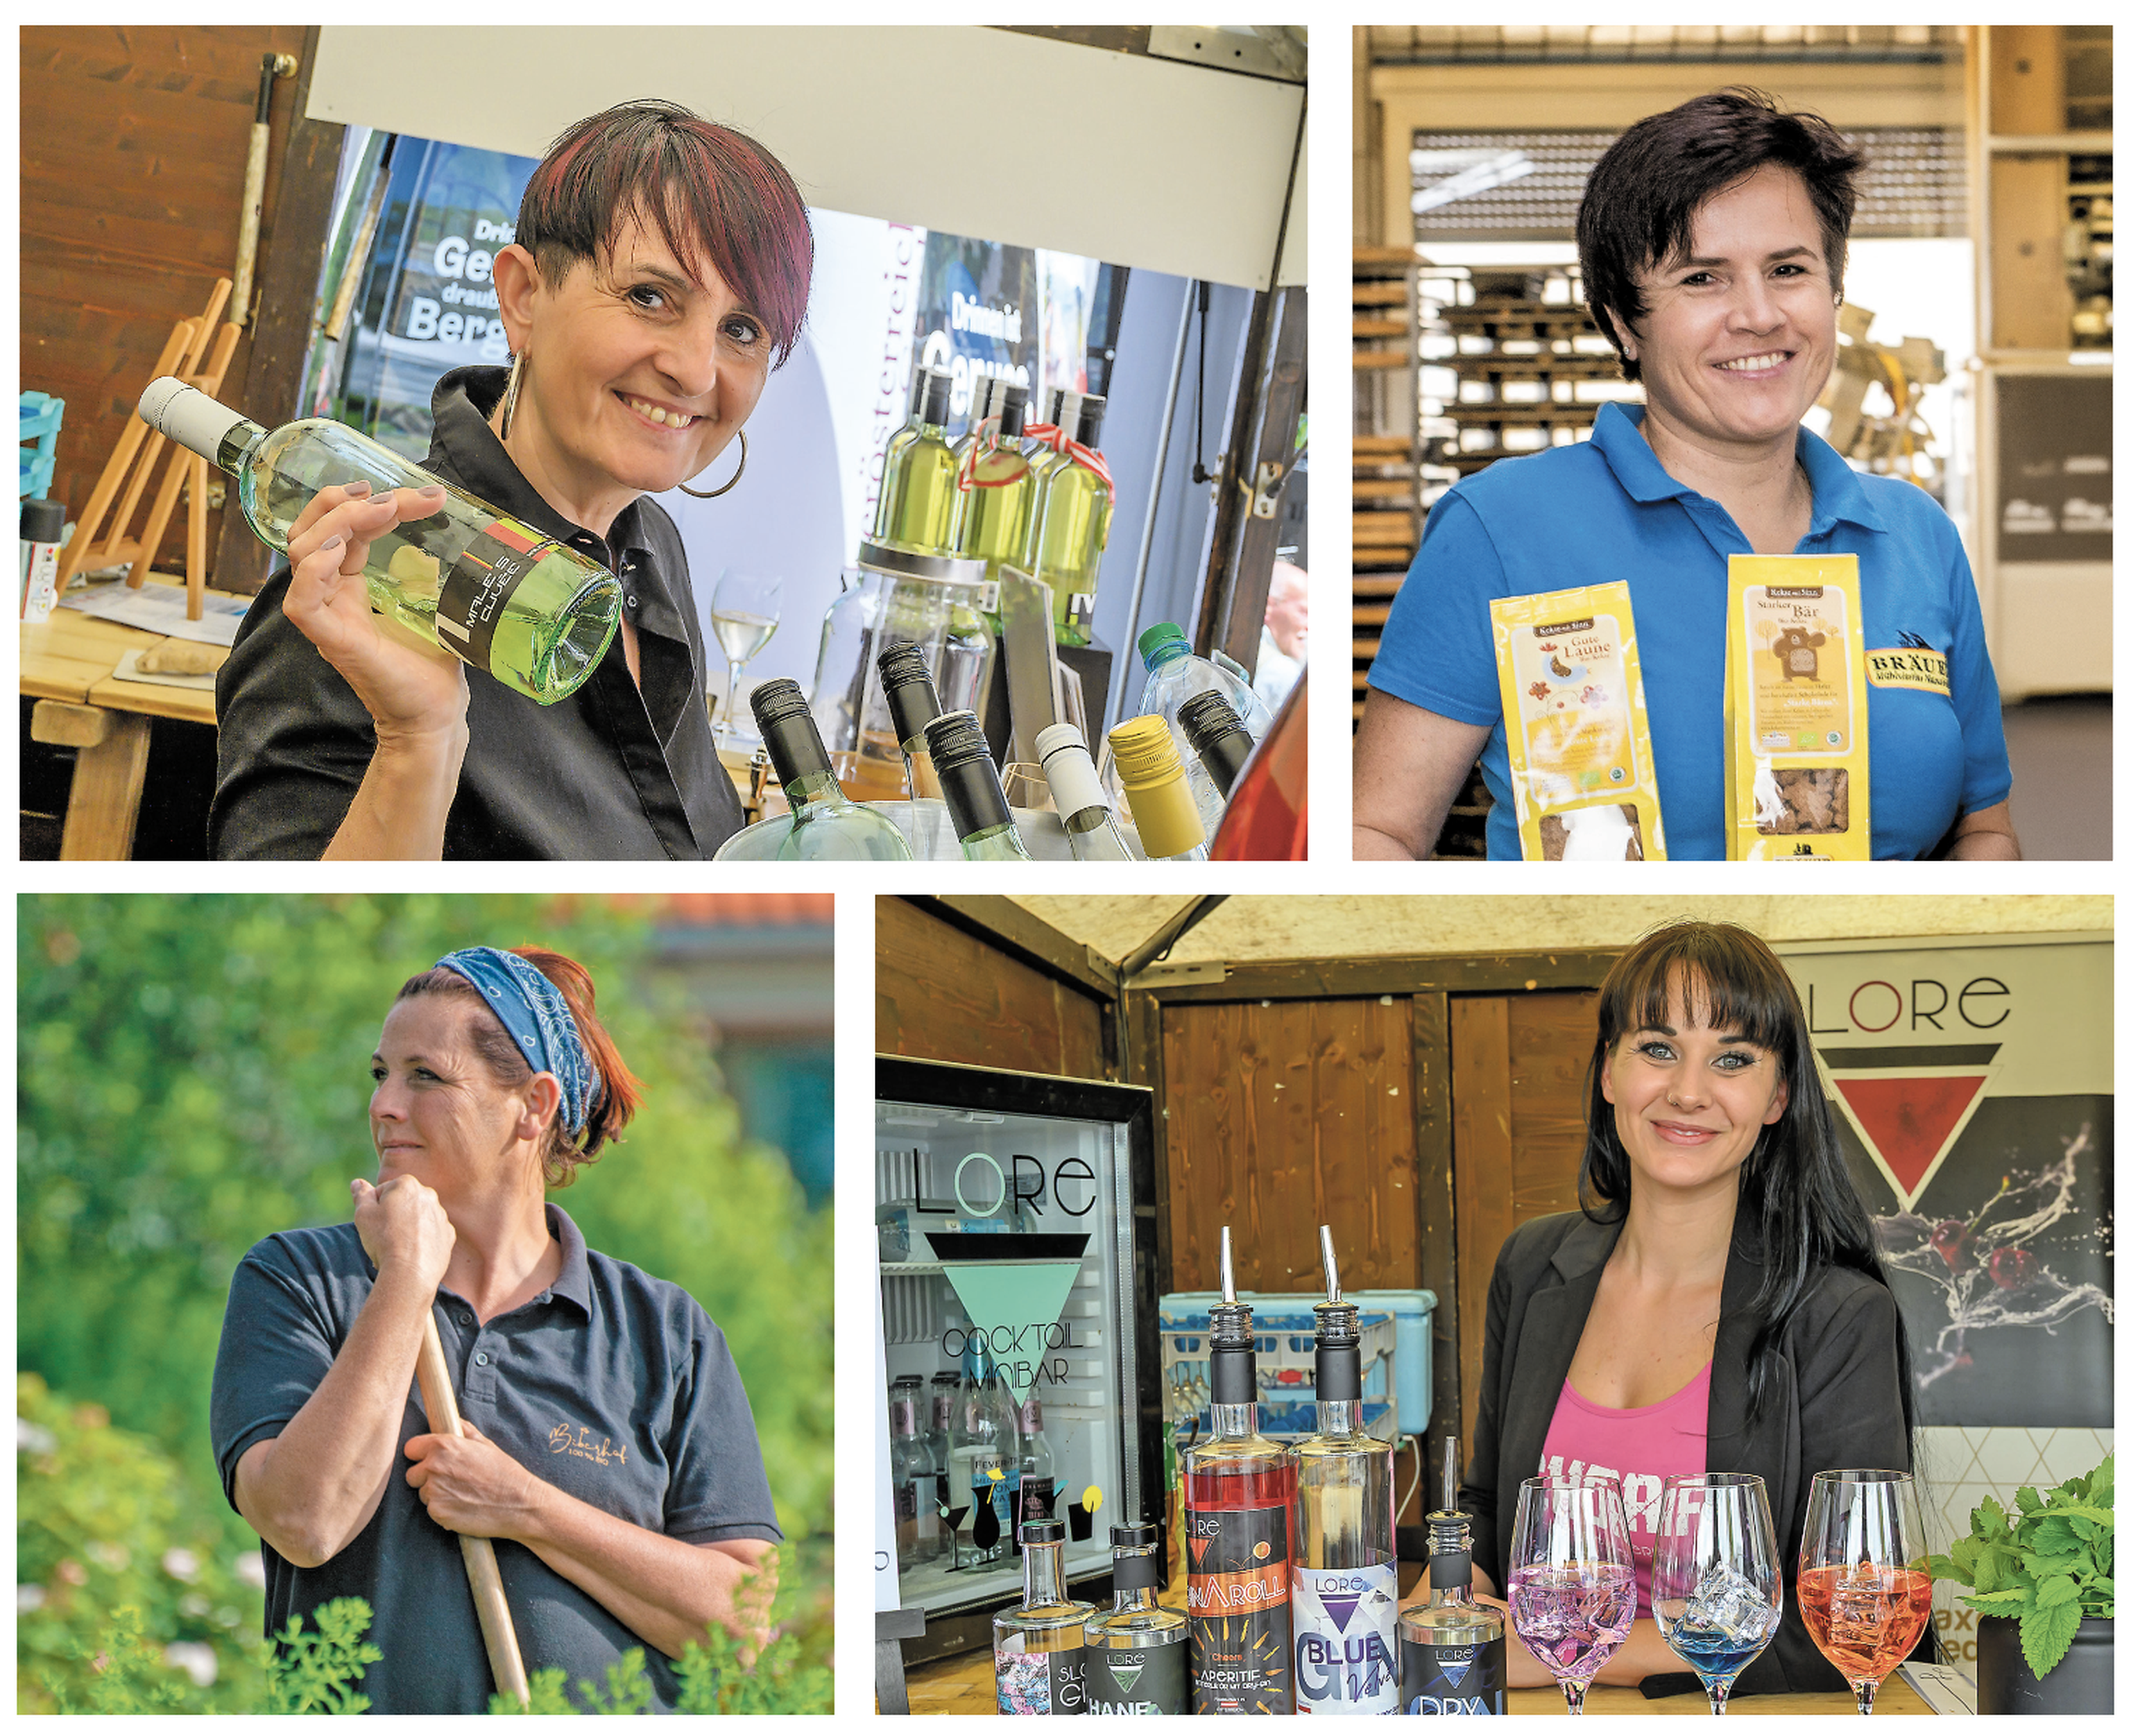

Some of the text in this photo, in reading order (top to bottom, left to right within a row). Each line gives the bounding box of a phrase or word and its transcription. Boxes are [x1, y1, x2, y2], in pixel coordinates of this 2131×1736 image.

[434, 236, 494, 284] Ge
[1757, 600, 1792, 609] Starker
[1792, 604, 1819, 619] Bär
[1571, 635, 1600, 646] Gute
[1564, 643, 1611, 658] Laune
[1308, 1636, 1382, 1665] BLUE
[1059, 1681, 1086, 1708] GI
